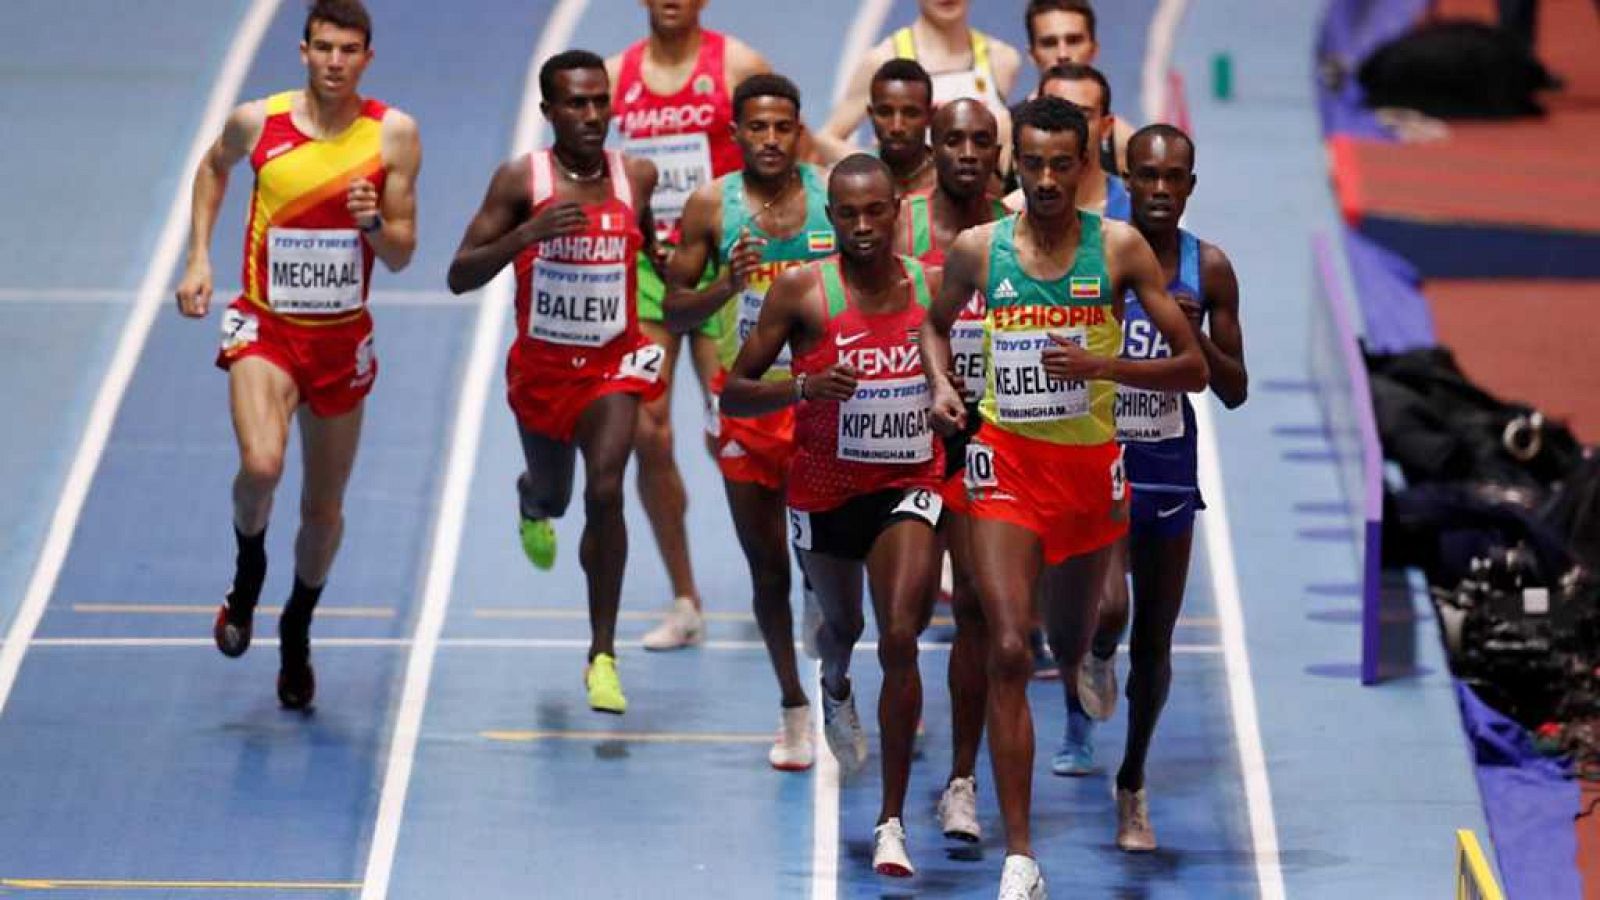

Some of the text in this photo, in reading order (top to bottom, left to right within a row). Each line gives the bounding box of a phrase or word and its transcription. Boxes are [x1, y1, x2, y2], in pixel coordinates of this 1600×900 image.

[625, 104, 714, 130] MAROC
[539, 236, 626, 260] BAHRAIN
[272, 262, 359, 288] MECHAAL
[537, 290, 619, 322] BALEW
[993, 305, 1106, 329] ETHIOPIA
[230, 317, 246, 339] 7
[630, 350, 661, 373] 12
[839, 345, 921, 375] KENYA
[856, 388, 891, 399] OYO
[968, 452, 990, 479] 10
